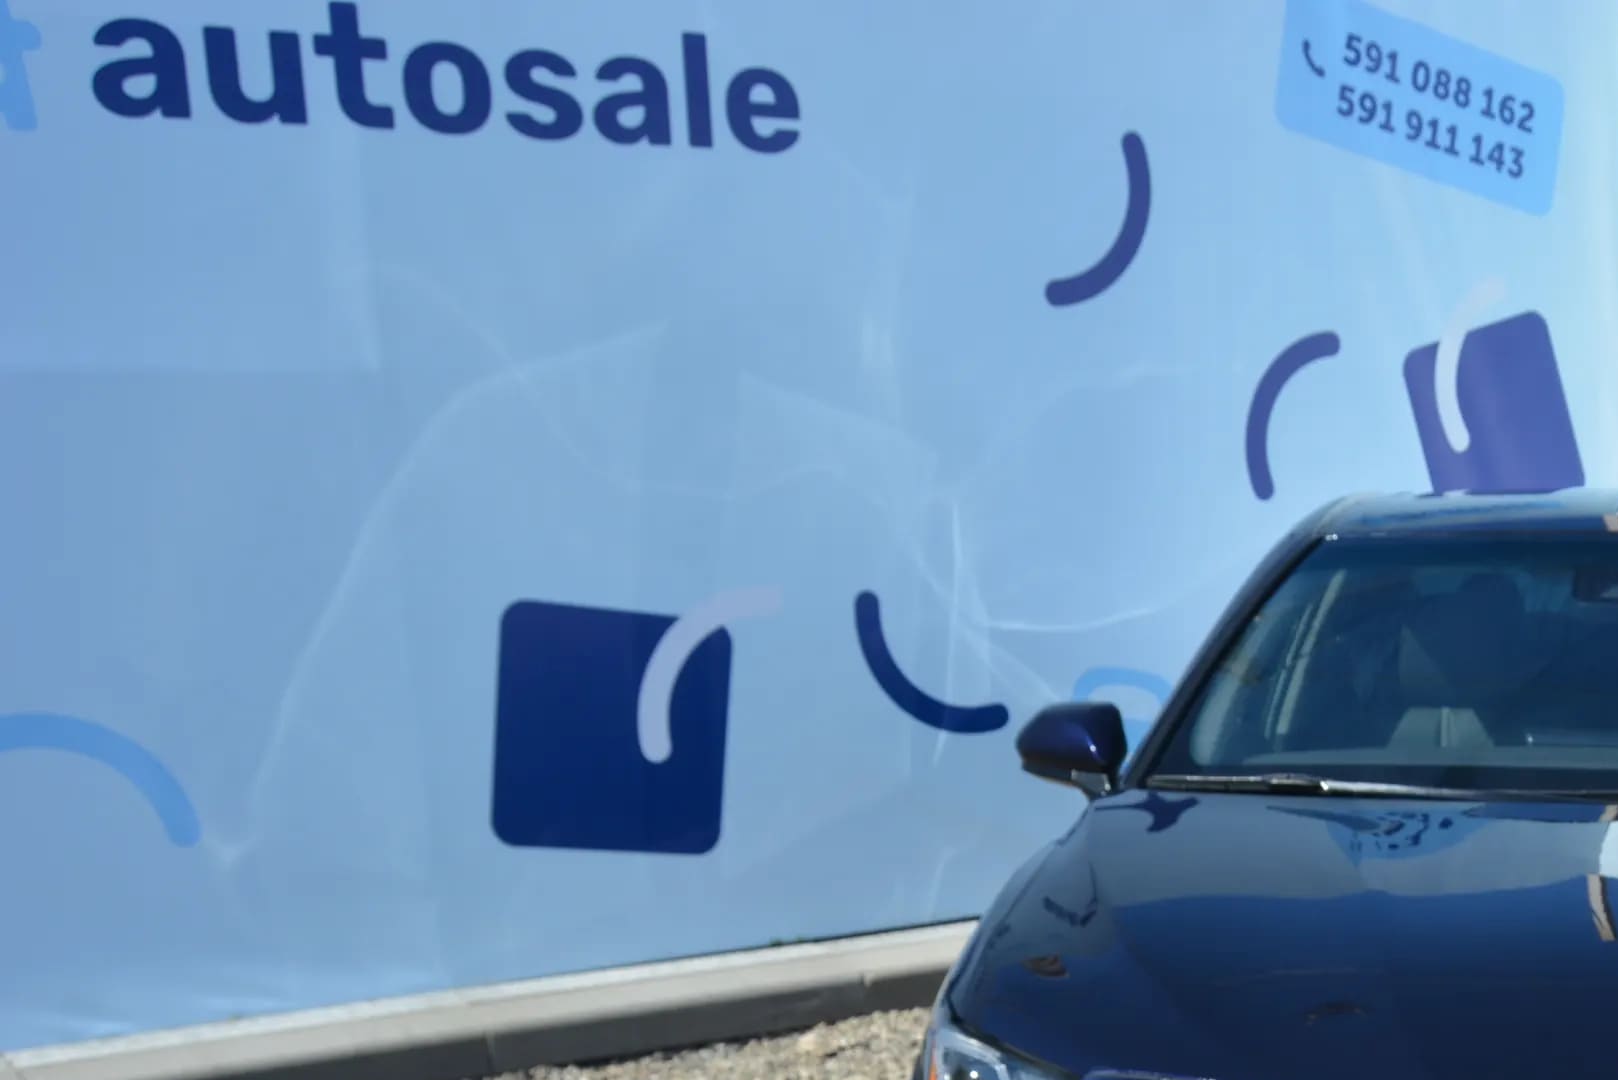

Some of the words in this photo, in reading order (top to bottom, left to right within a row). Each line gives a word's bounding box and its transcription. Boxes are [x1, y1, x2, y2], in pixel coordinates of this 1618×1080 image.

[92, 1, 801, 153] autosale
[1342, 32, 1401, 84] 591
[1411, 60, 1472, 109] 088
[1480, 86, 1535, 134] 162
[1337, 83, 1396, 133] 591
[1405, 109, 1461, 157] 911
[1469, 133, 1525, 180] 143
